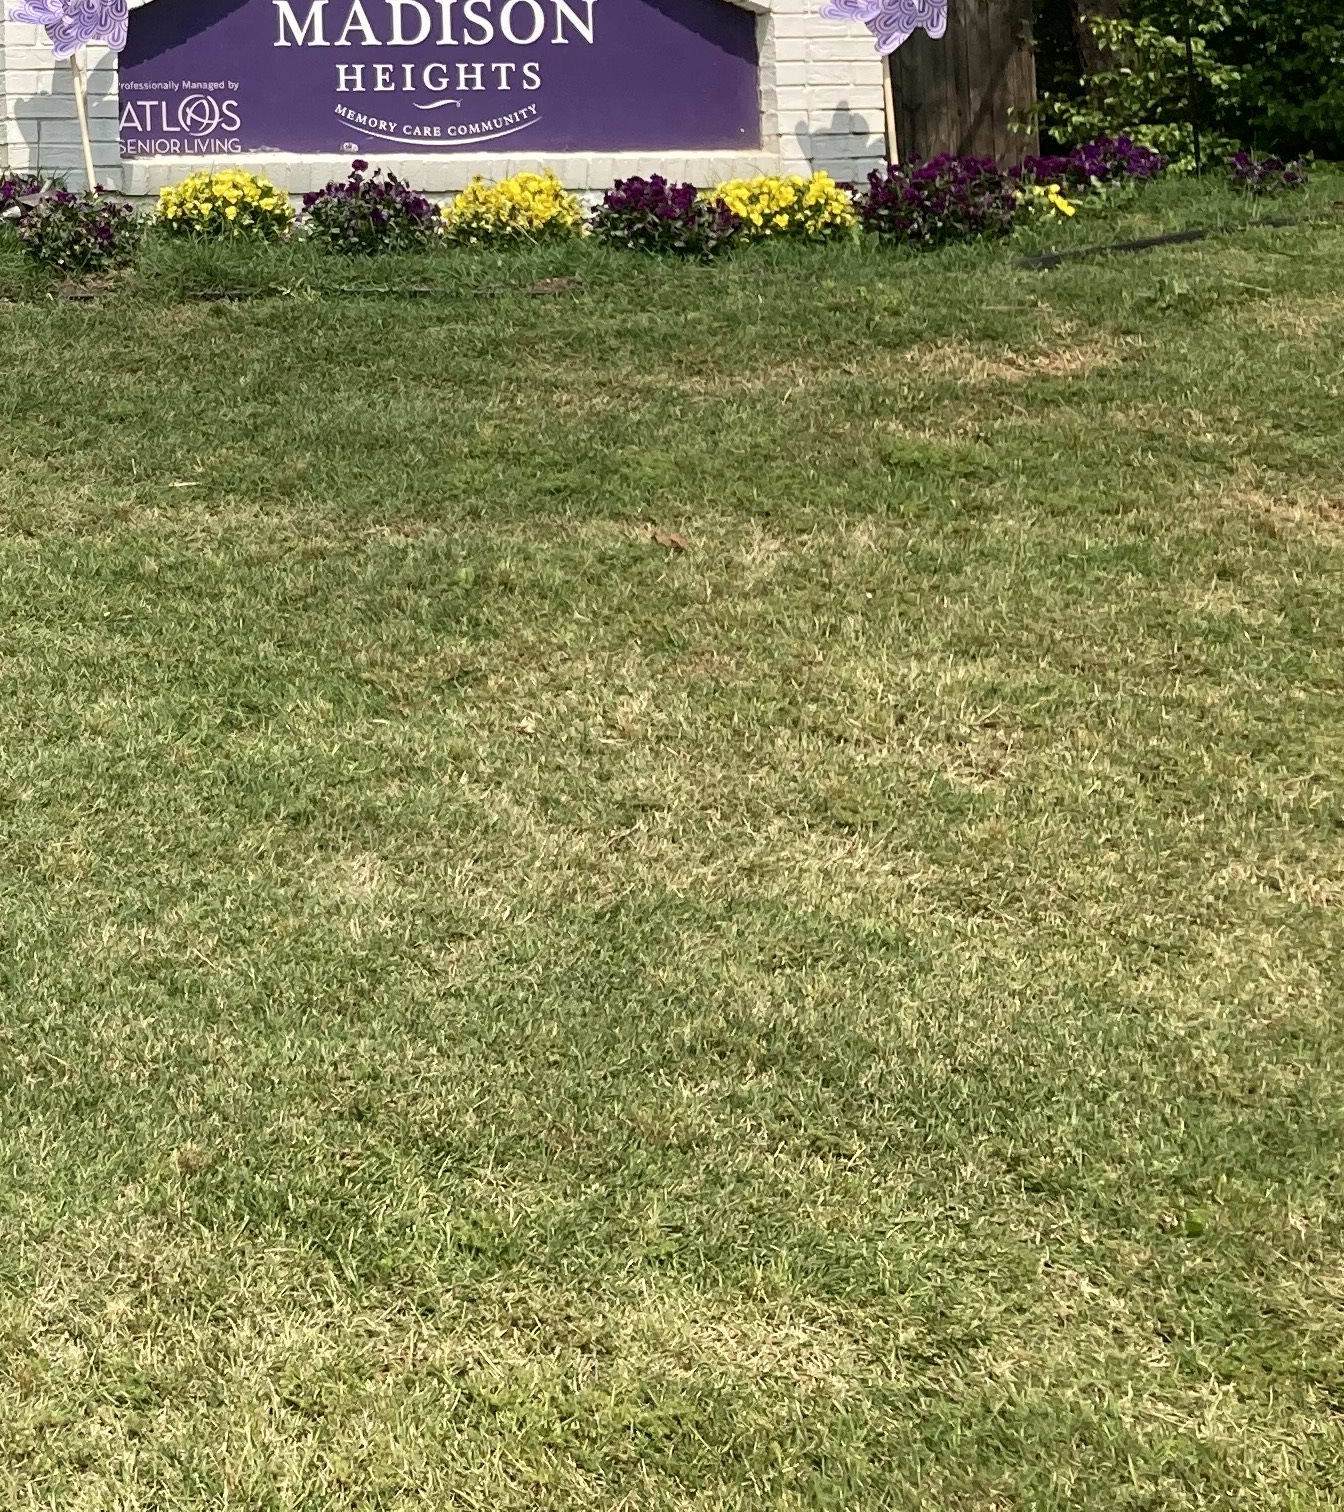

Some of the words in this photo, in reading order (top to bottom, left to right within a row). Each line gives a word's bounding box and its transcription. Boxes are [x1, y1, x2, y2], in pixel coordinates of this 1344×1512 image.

[119, 80, 179, 92] rofessionally
[182, 80, 224, 91] Managed
[227, 80, 240, 91] by
[335, 62, 542, 92] HEIGHTS
[334, 103, 398, 133] MEMORY
[403, 124, 441, 137] CARE
[447, 103, 538, 136] COMMUNITY
[184, 138, 242, 153] LIVING
